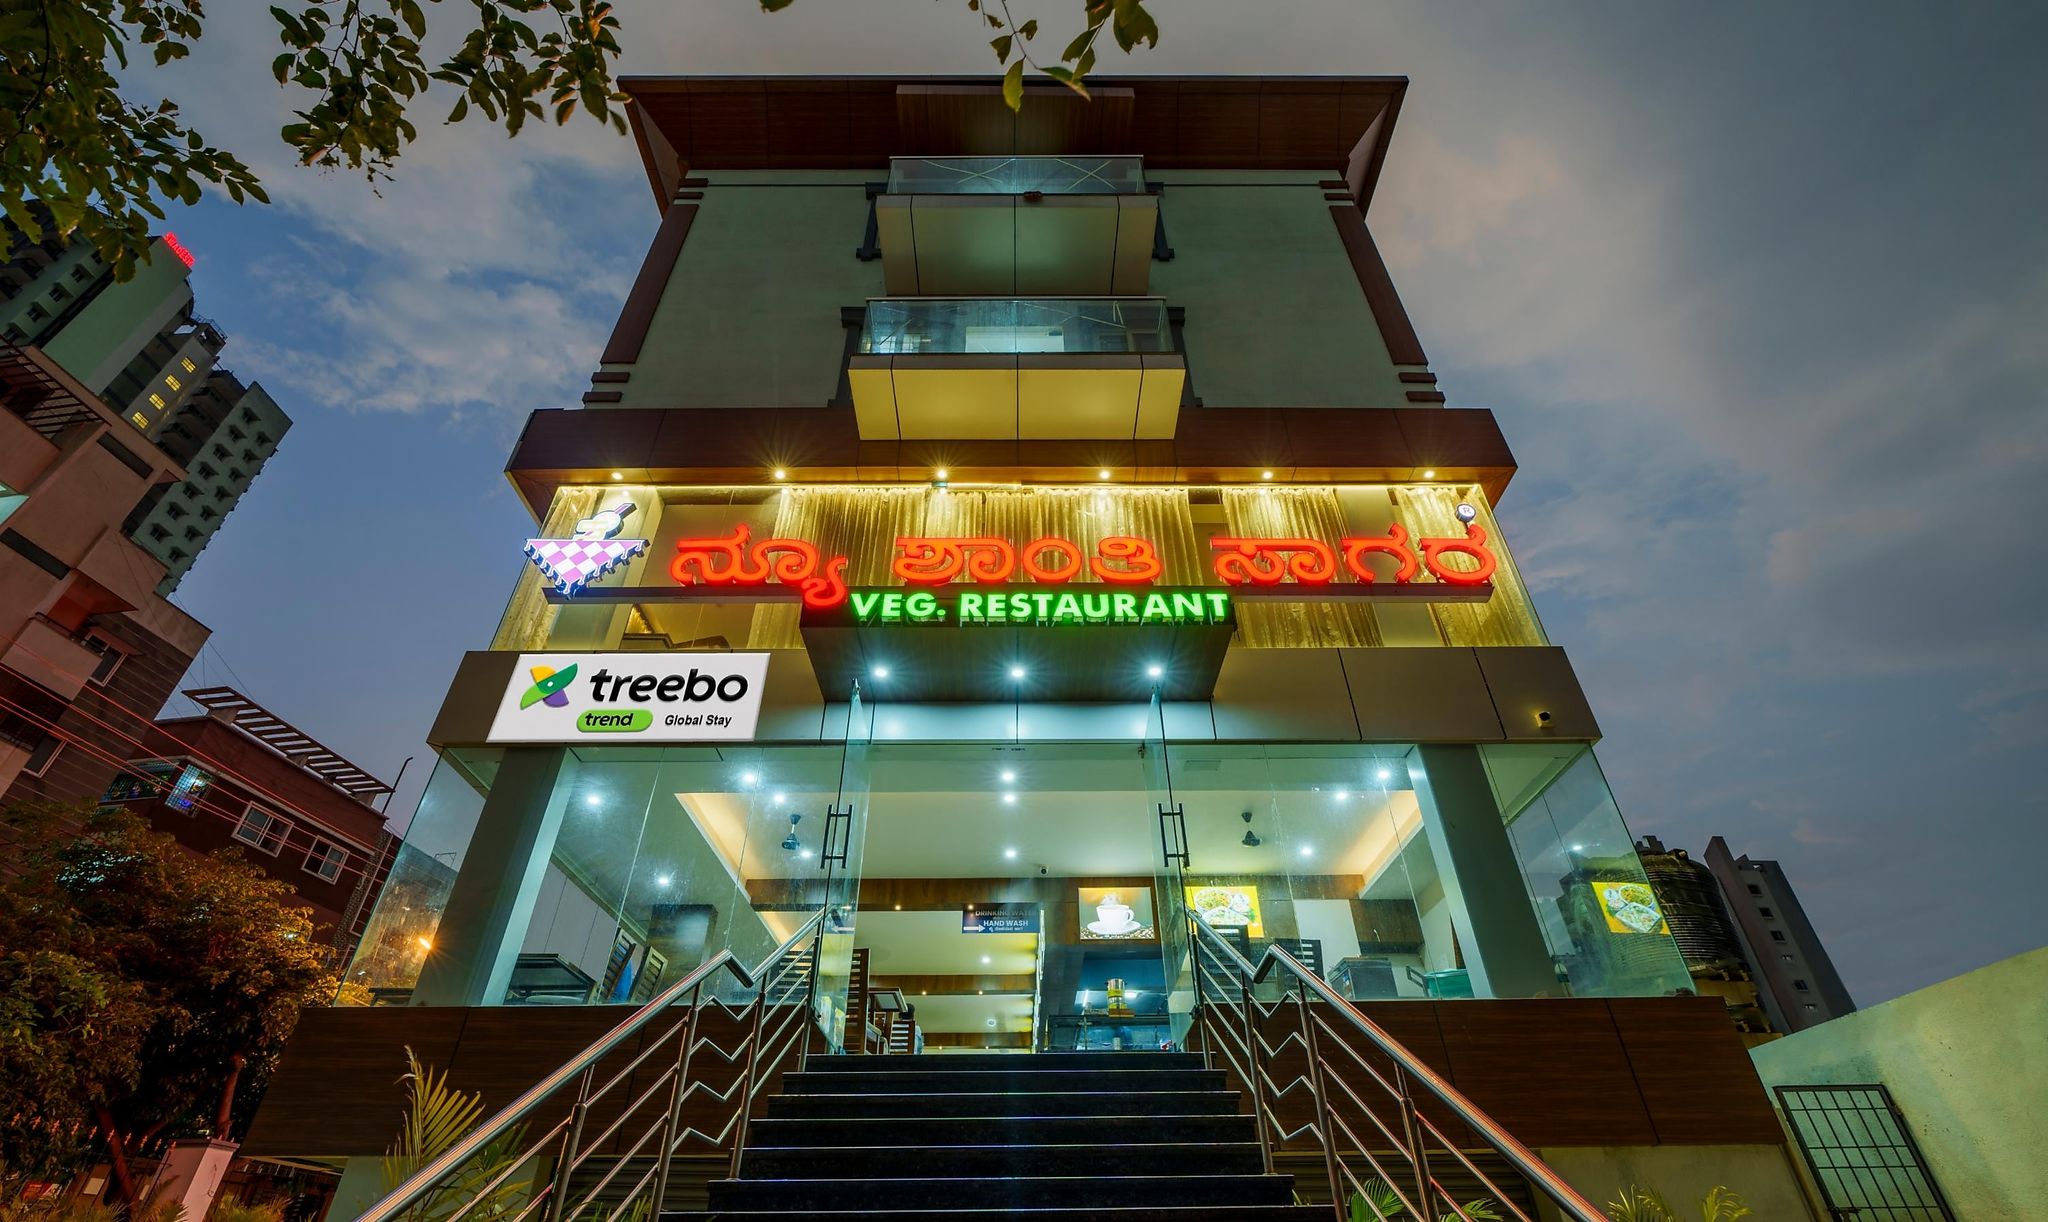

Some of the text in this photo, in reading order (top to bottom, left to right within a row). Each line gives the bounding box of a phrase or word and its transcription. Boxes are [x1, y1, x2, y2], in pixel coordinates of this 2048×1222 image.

[894, 536, 1162, 584] ಶಾಂತಿ
[1210, 522, 1497, 584] ಸಾಗರ
[851, 592, 1229, 618] VEG. RESTAURANT
[590, 668, 749, 703] treebo
[585, 712, 633, 727] trend
[664, 714, 732, 729] Global Stay
